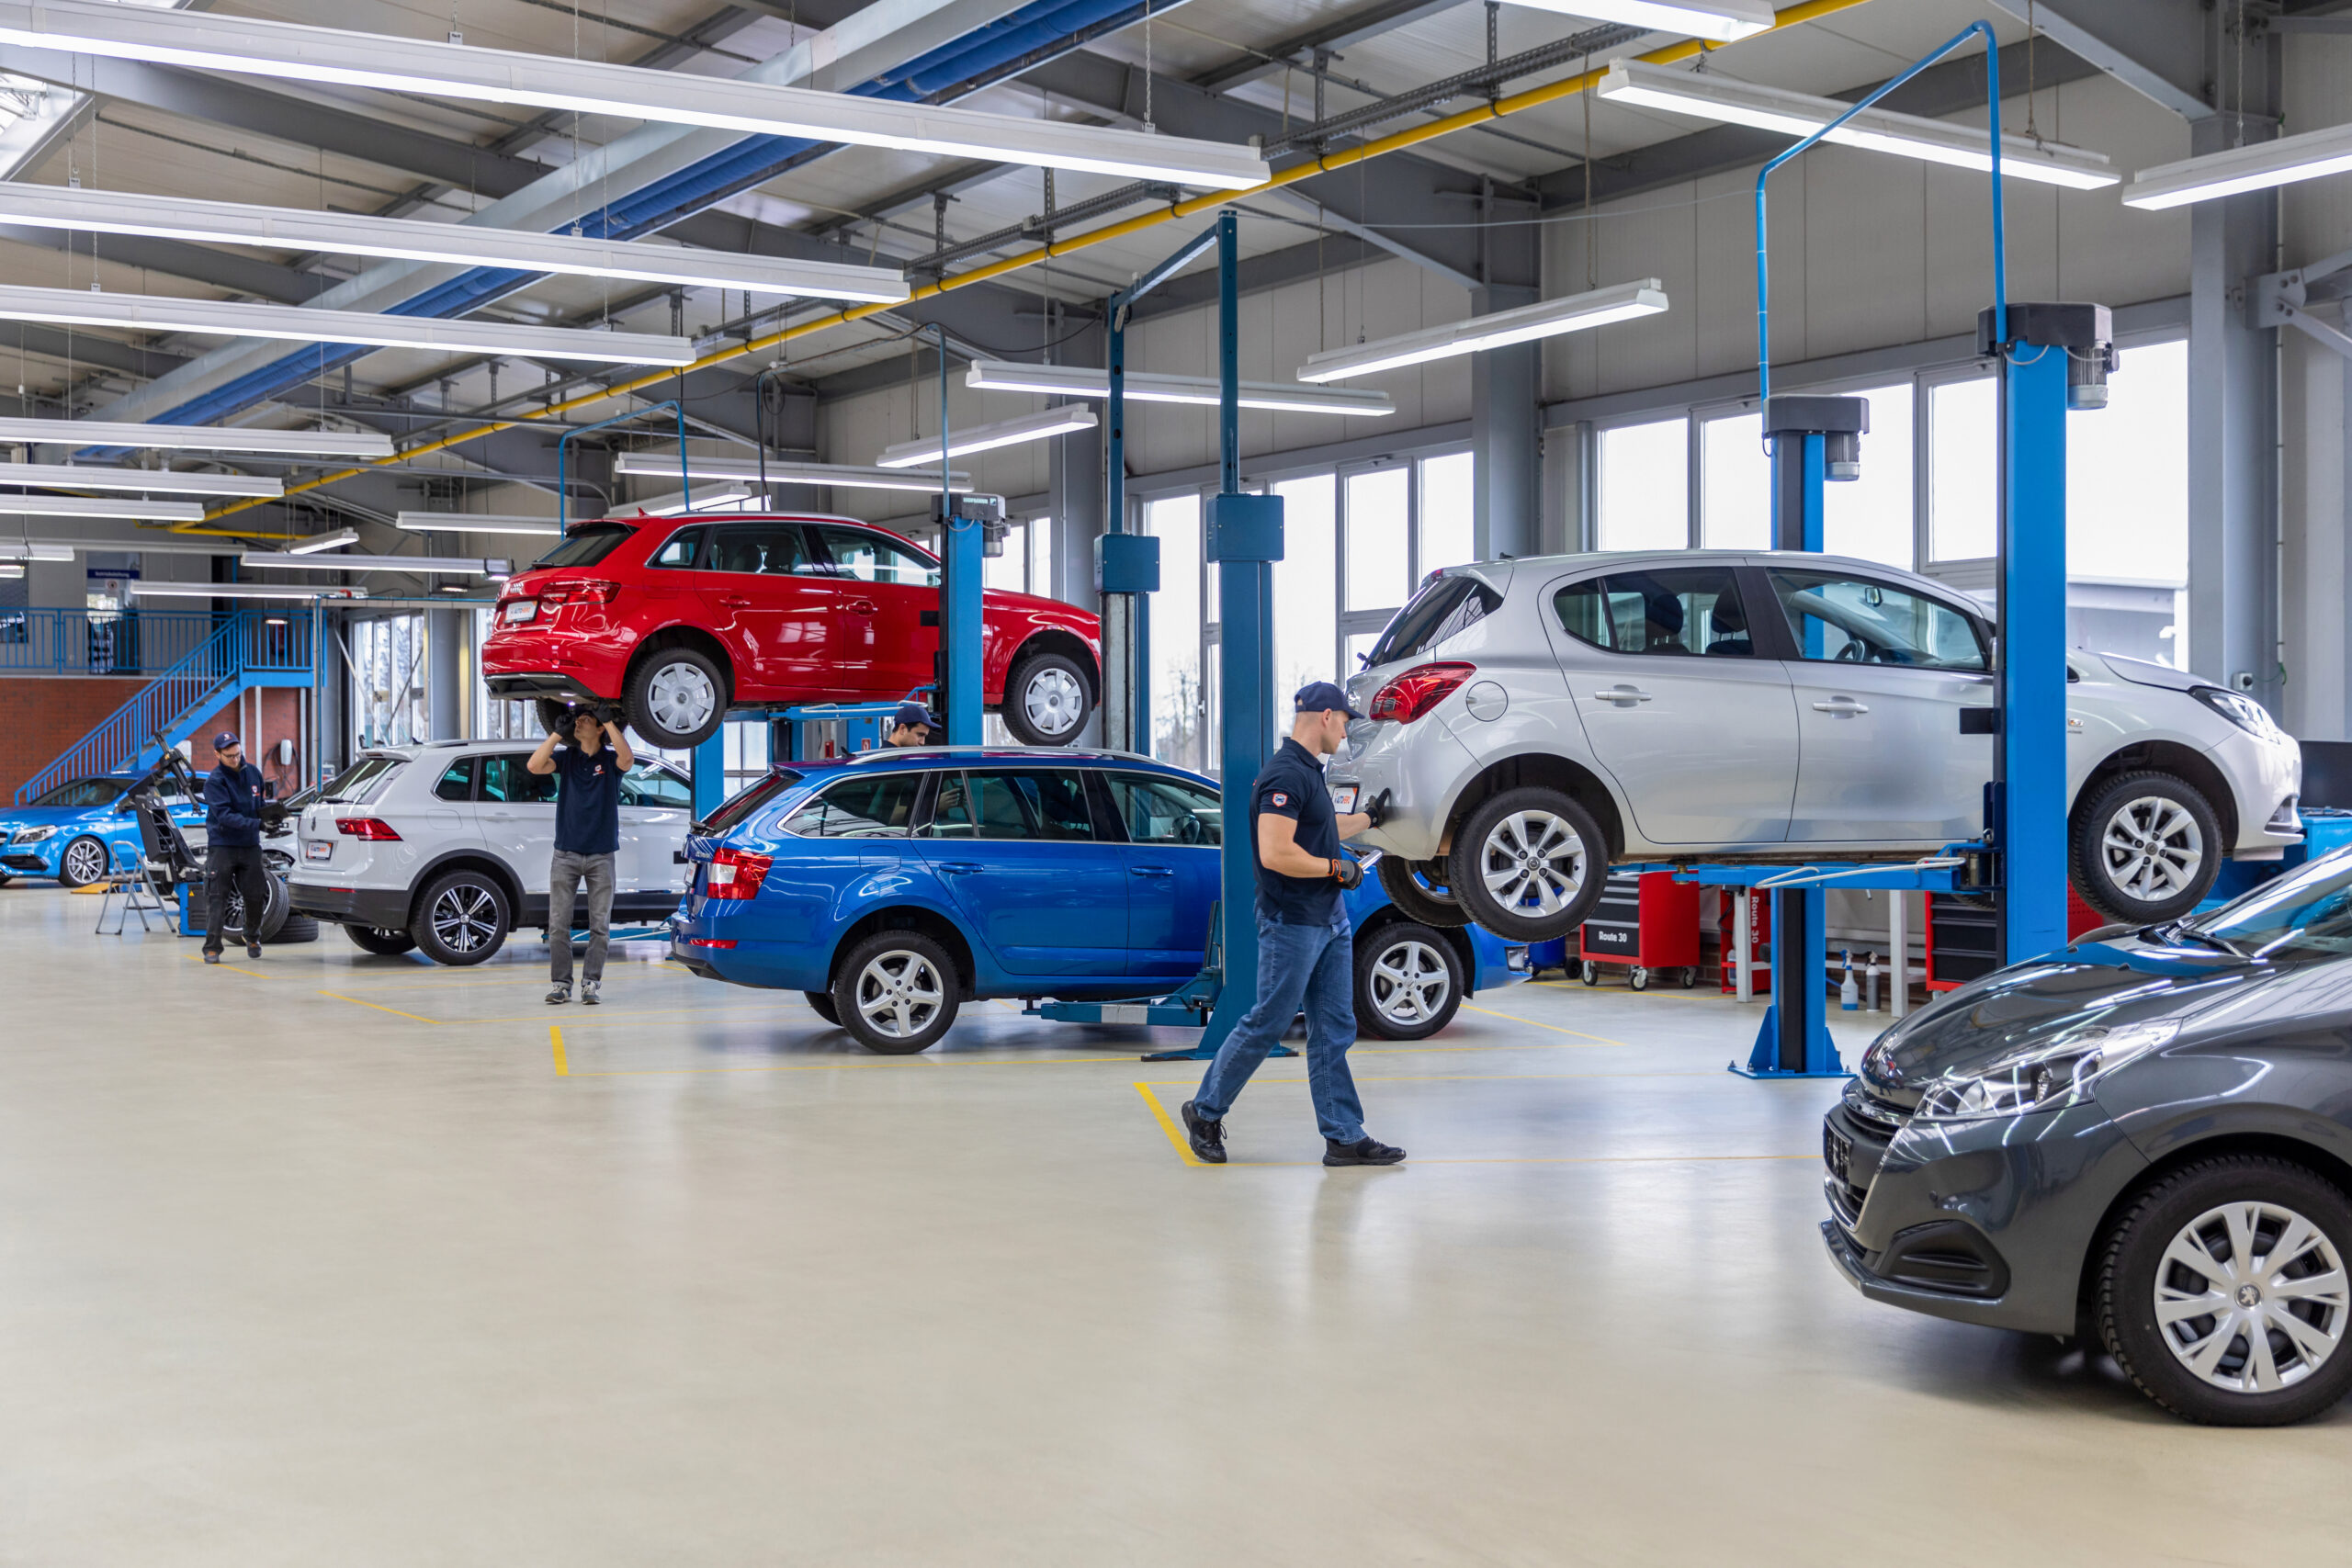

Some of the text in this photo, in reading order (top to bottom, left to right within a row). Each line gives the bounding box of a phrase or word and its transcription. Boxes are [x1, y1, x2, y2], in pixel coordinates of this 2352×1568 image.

[1751, 896, 1759, 943] Route 30
[1599, 931, 1627, 942] Route 30
